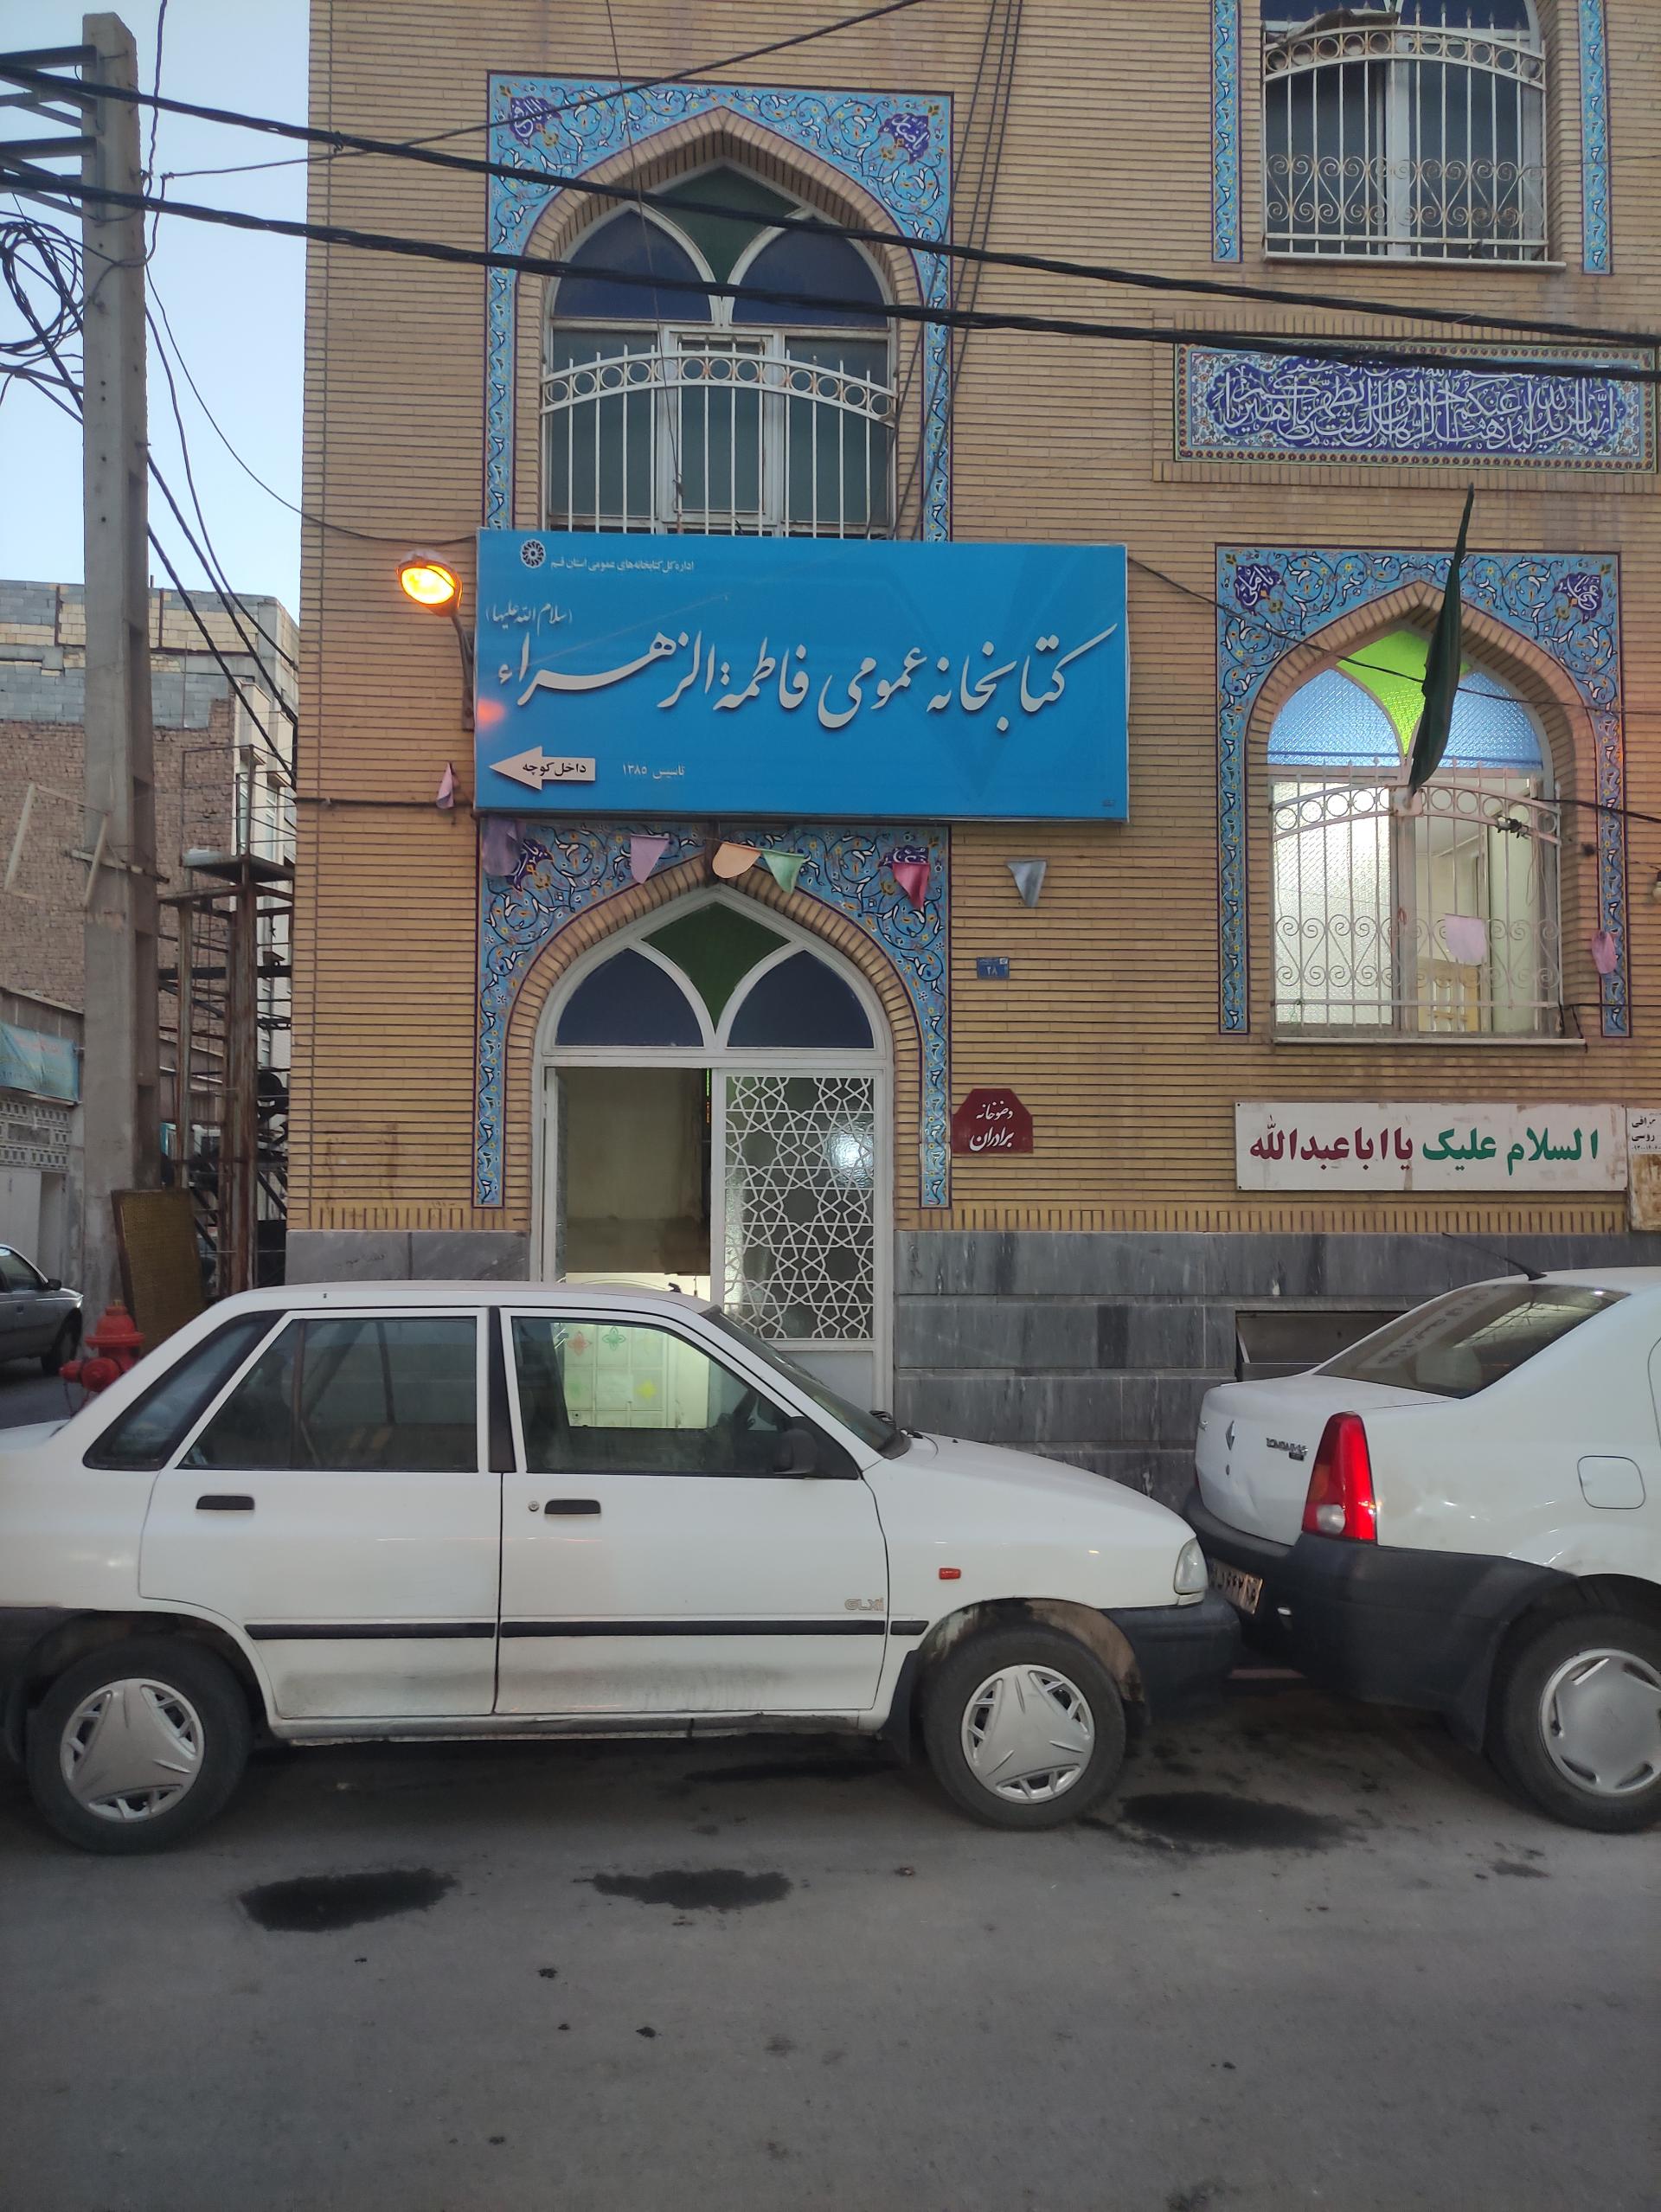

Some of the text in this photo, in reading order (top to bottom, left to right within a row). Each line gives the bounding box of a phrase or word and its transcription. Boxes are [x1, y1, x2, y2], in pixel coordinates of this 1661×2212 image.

[550, 556, 565, 570] قم
[567, 555, 587, 568] استان
[588, 561, 615, 572] عمومی
[818, 647, 928, 728] عمومی
[927, 623, 1118, 732] کتابخانه
[522, 761, 587, 777] داخل کوچه
[976, 1100, 1014, 1121] وضوخانه
[969, 1126, 1015, 1151] برادران
[1422, 1127, 1497, 1171] علیک
[1506, 1127, 1599, 1176] السلام
